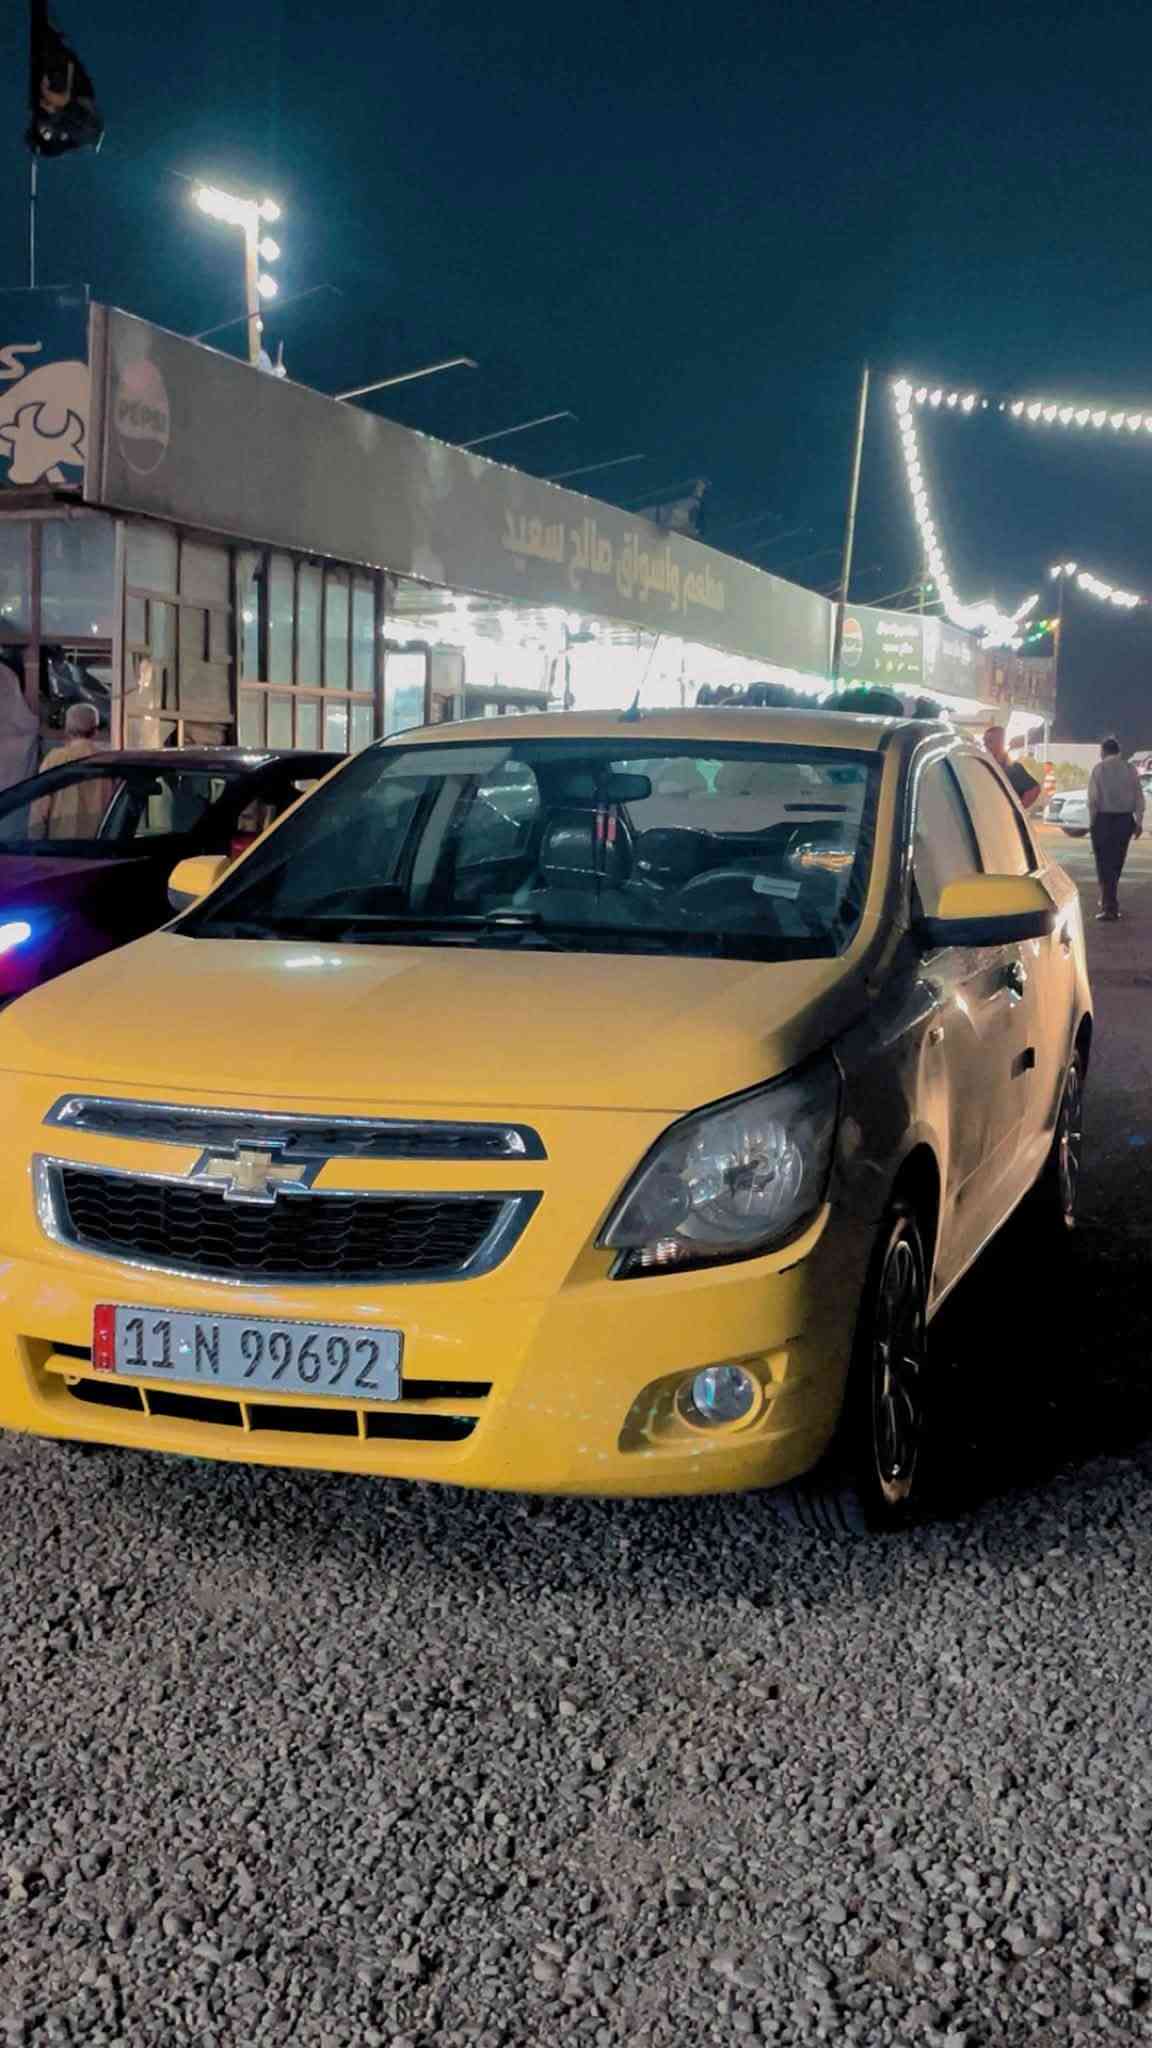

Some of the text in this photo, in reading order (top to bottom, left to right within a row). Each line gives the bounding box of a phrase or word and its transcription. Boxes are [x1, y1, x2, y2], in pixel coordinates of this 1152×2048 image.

[124, 1317, 176, 1369] 11
[194, 1323, 221, 1375] N
[240, 1328, 381, 1390] 99692
